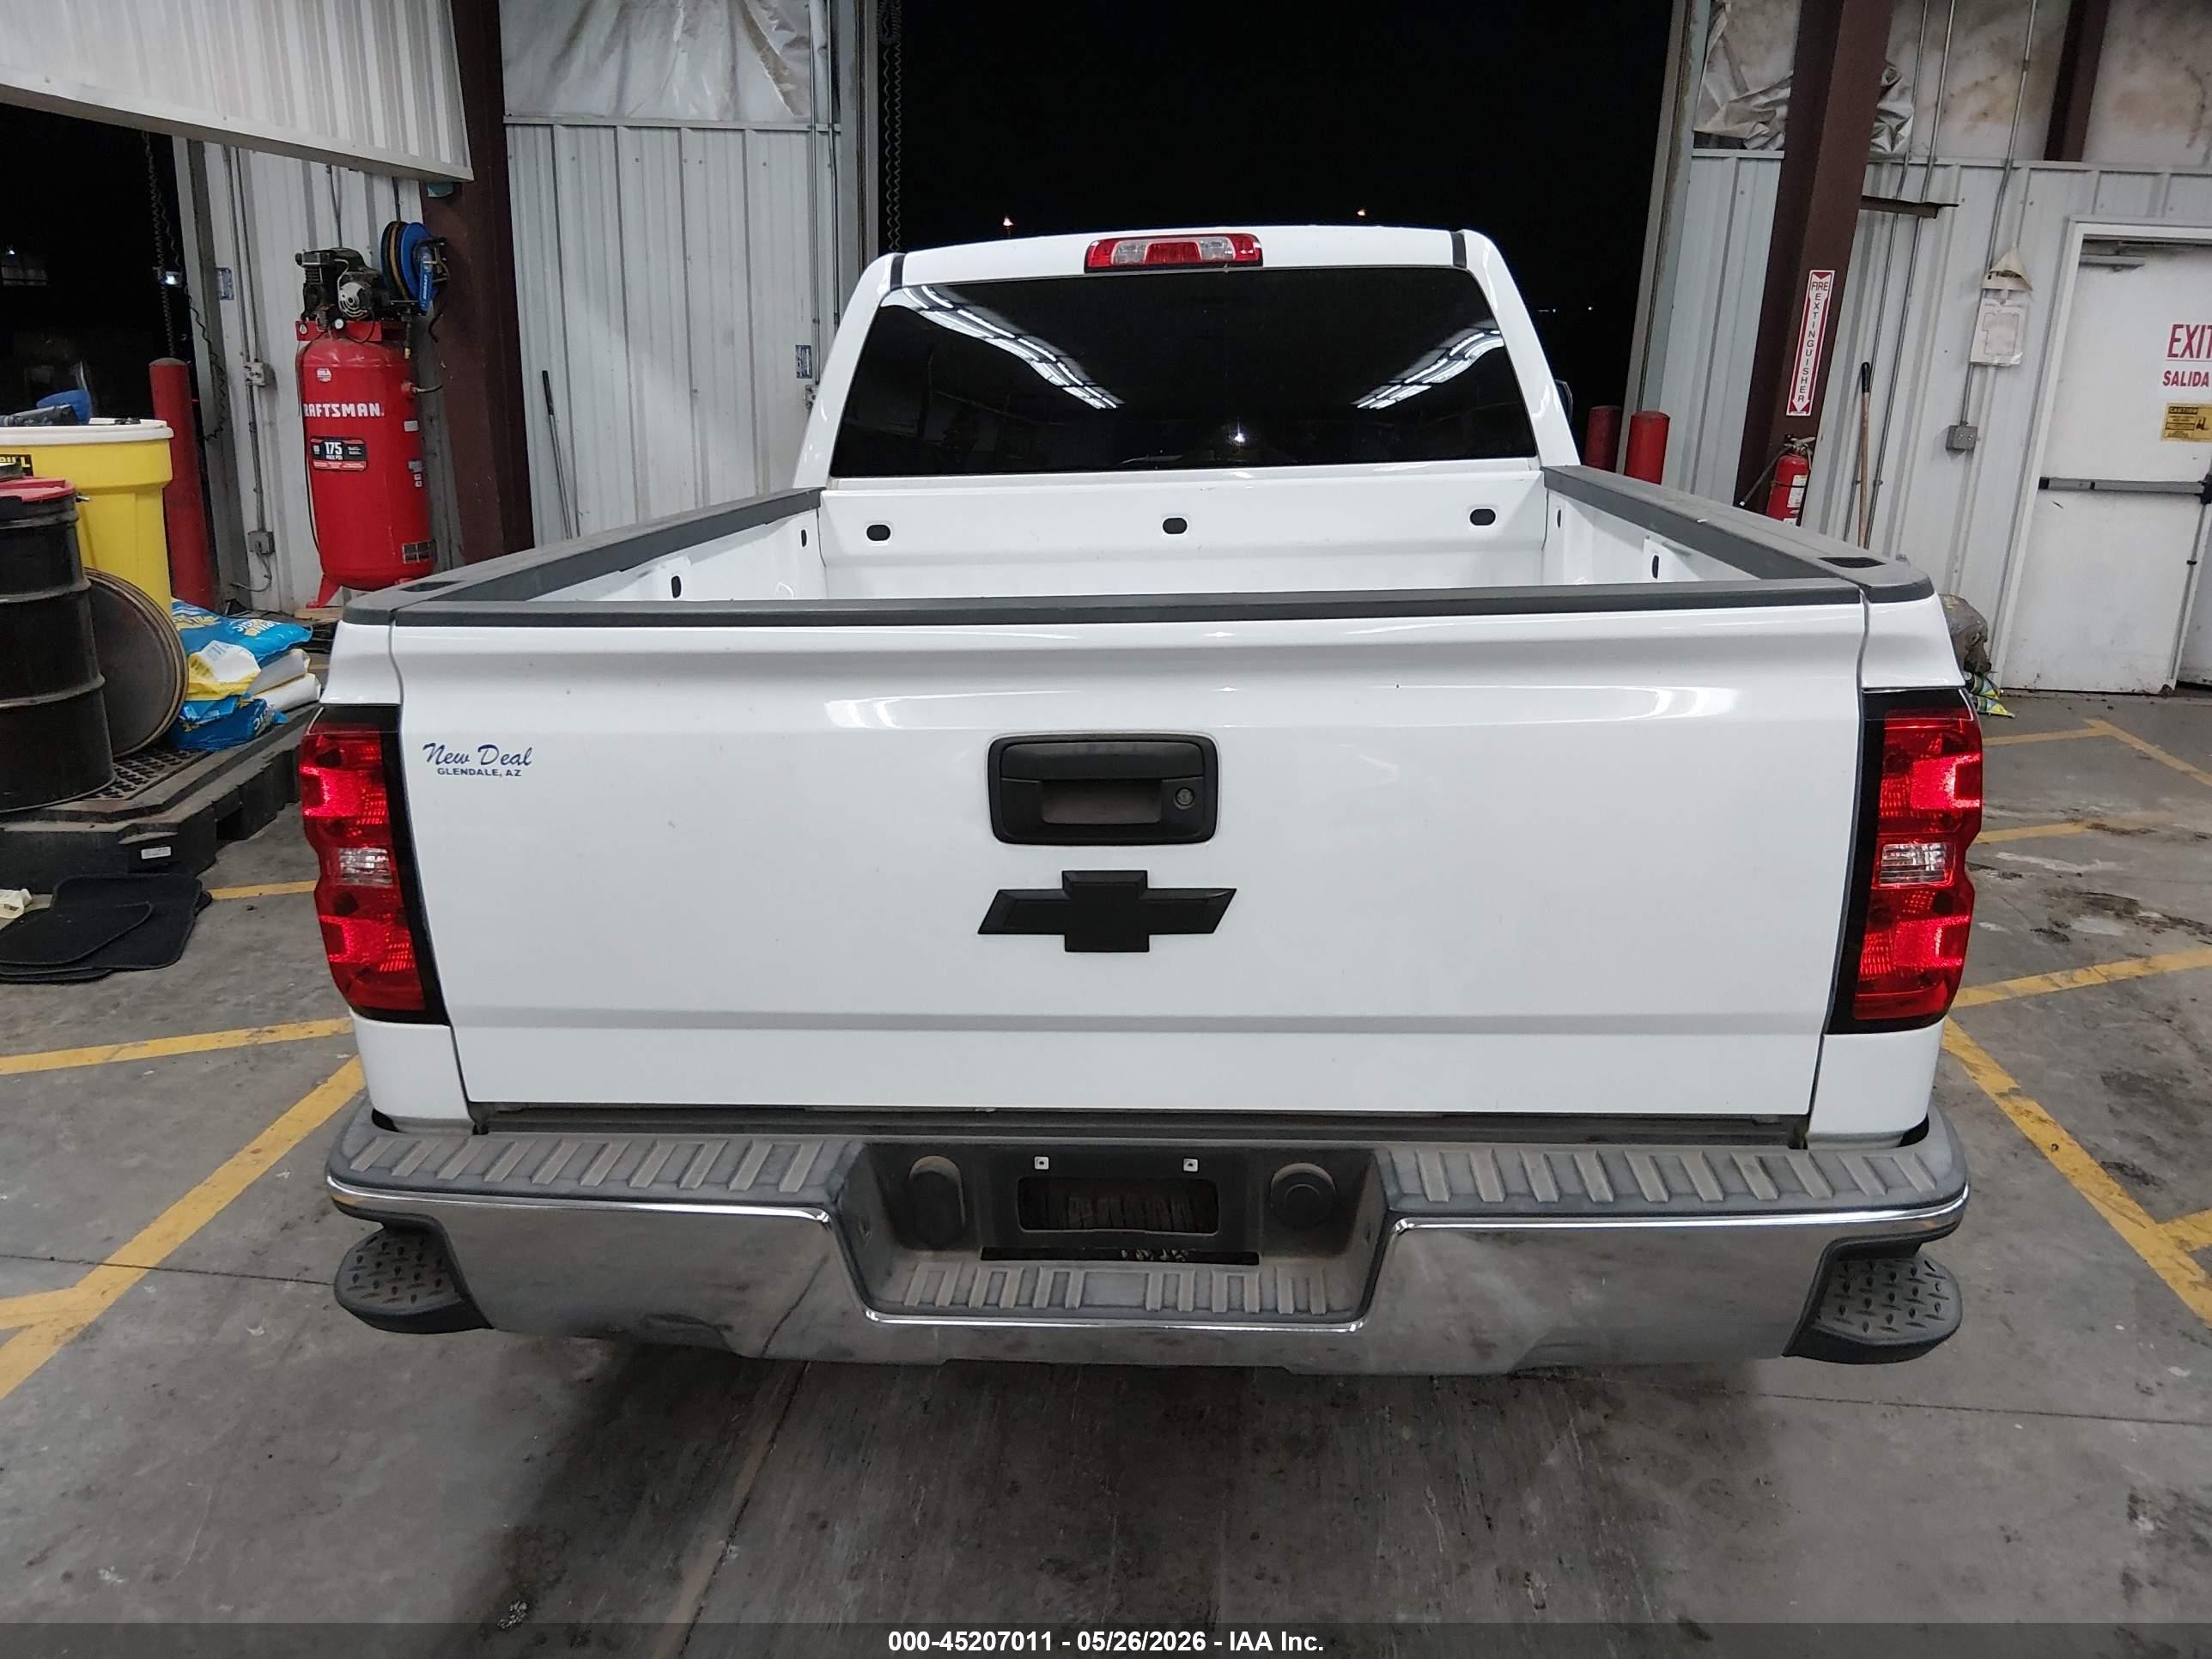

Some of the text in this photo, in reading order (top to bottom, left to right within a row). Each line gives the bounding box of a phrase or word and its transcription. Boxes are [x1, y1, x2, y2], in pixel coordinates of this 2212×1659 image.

[1811, 281, 1828, 291] FIRE
[1797, 293, 1822, 402] EXTINGUISHER
[2163, 370, 2209, 387] SALIDA
[325, 442, 343, 455] 175
[422, 743, 532, 765] New Deal
[437, 768, 502, 778] GLENDALE,
